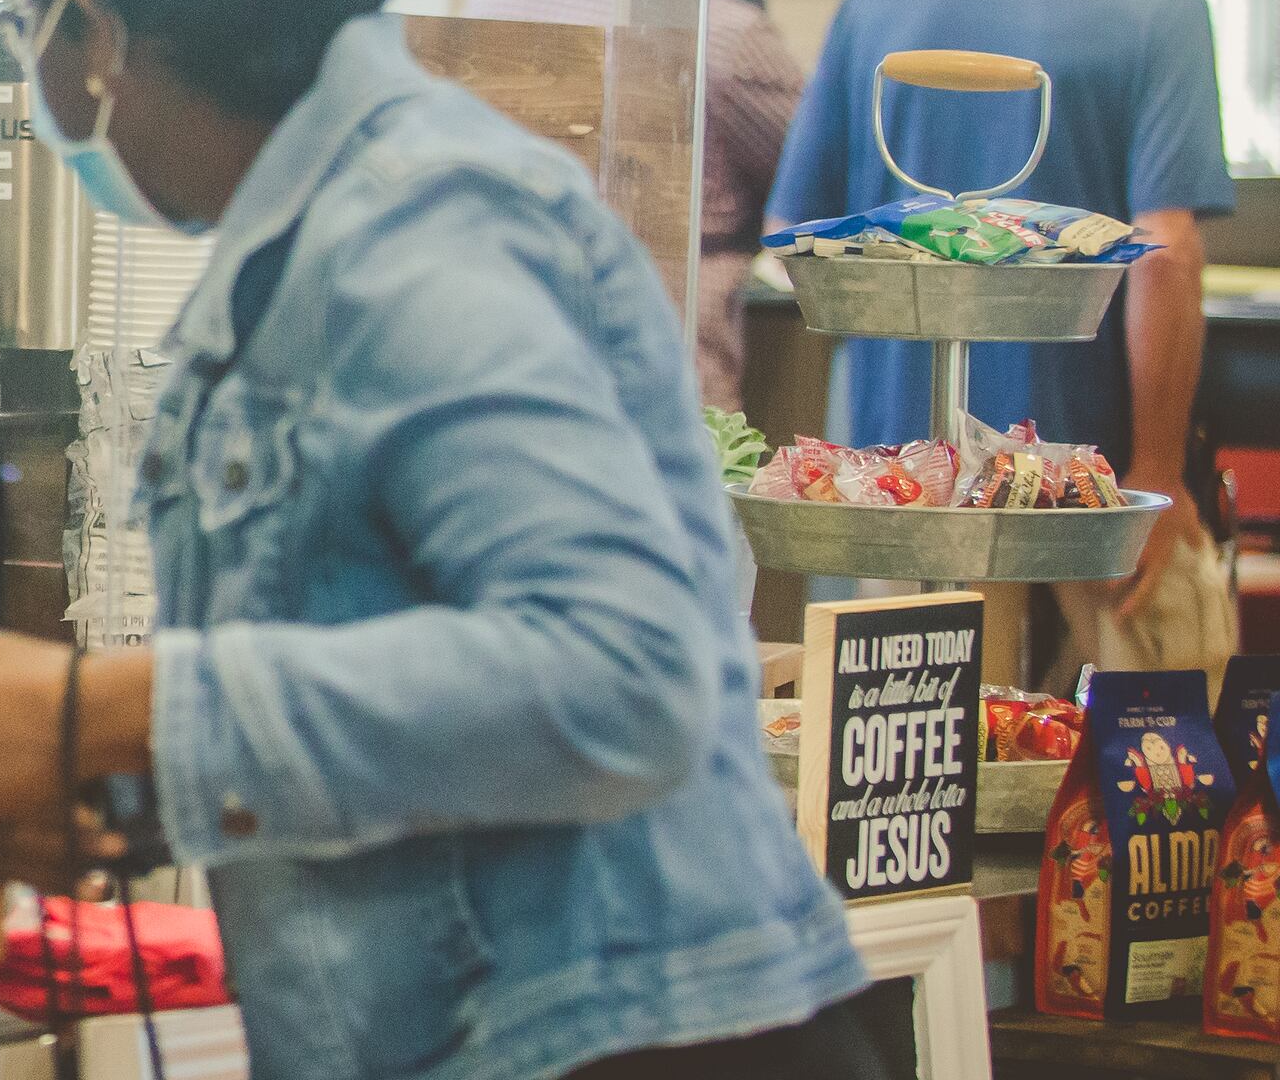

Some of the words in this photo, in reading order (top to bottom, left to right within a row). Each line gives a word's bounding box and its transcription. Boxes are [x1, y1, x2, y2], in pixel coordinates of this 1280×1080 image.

[838, 638, 869, 674] ALL
[871, 637, 879, 671] I
[881, 633, 924, 670] NEED
[925, 629, 975, 665] TODAY
[848, 684, 865, 709] is
[864, 687, 881, 708] a
[879, 671, 915, 707] little
[912, 670, 940, 703] bit
[938, 666, 961, 711] of
[841, 707, 965, 787] COFFEE
[831, 784, 874, 821] and
[866, 796, 883, 817] a
[882, 778, 931, 815] whole
[929, 776, 966, 810] lotta
[845, 810, 951, 890] JESUS
[1128, 829, 1220, 896] ALMA
[1127, 896, 1209, 921] COFFE
